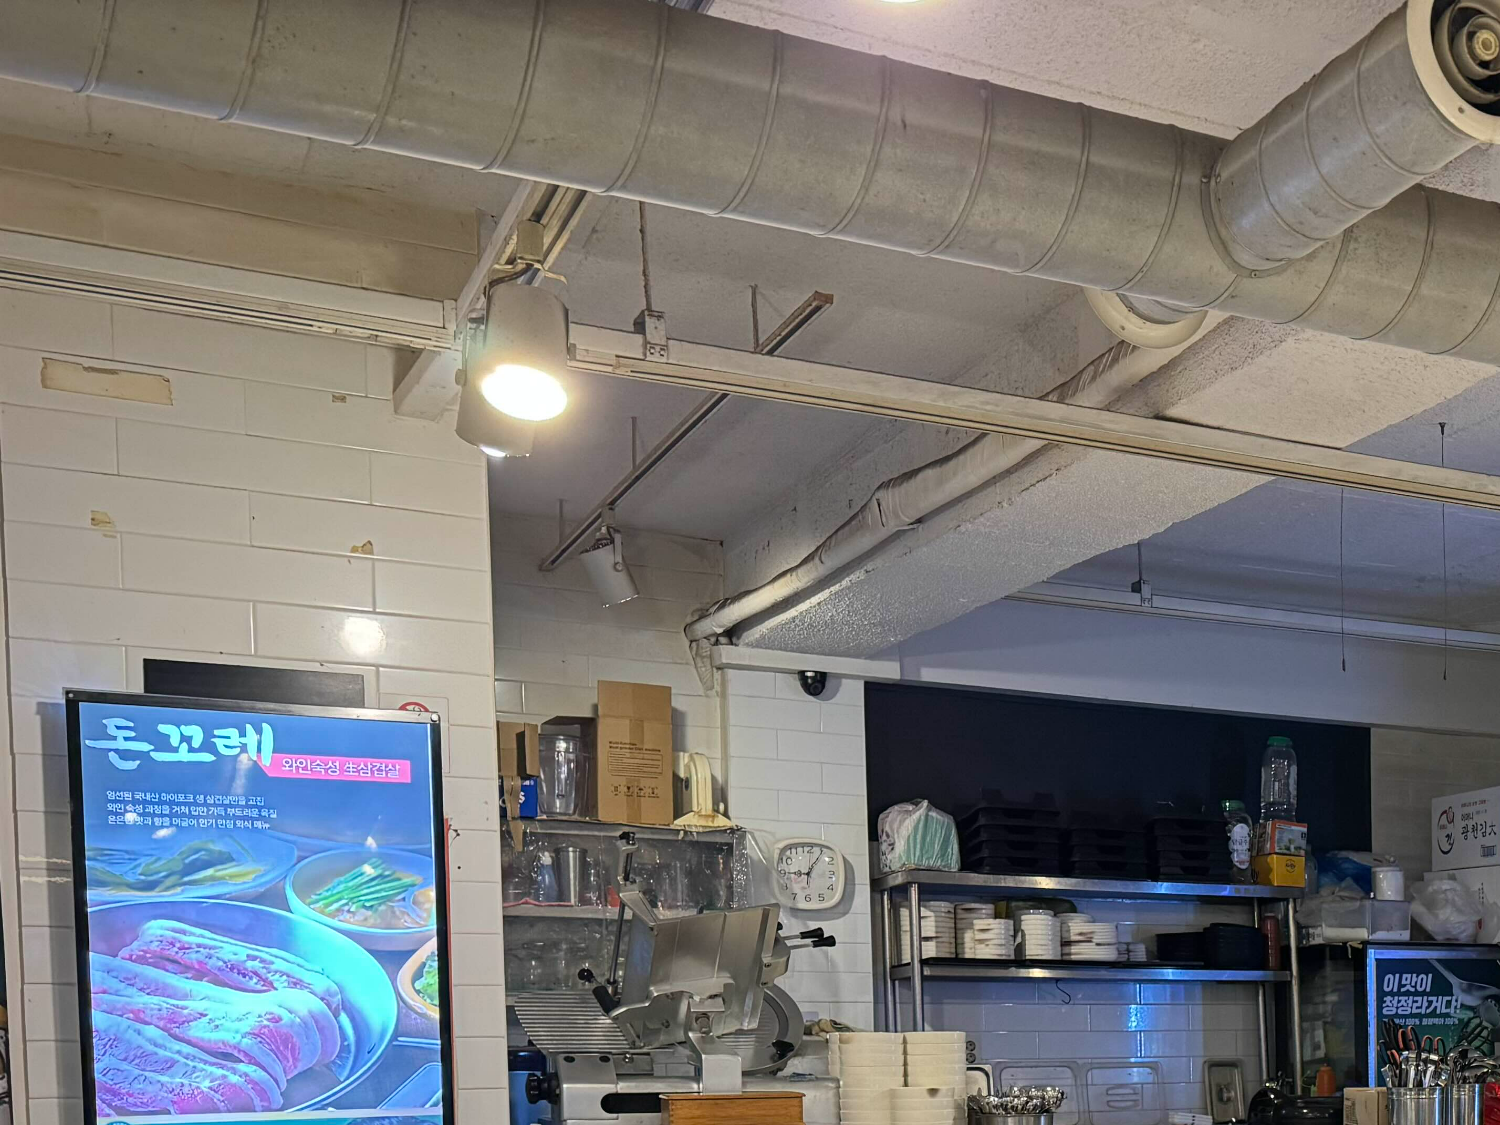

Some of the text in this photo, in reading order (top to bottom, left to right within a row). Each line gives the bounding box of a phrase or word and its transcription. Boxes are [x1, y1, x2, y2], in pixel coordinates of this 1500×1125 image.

[85, 717, 274, 771] 돈꼬레
[281, 758, 400, 779] 와인숙성 生삼겹살
[133, 791, 160, 802] 국내산
[106, 803, 125, 813] 와인
[144, 804, 170, 815] 과정을
[189, 806, 208, 817] 입안
[208, 807, 226, 817] 가득
[226, 808, 260, 818] 부드러운
[153, 816, 171, 827] 향을
[172, 817, 198, 828] 머금어
[199, 818, 216, 829] 인기
[235, 820, 252, 830] 외식
[789, 847, 798, 855] 11
[802, 846, 814, 854] 12
[780, 856, 793, 866] 10
[827, 856, 835, 866] 2
[779, 868, 787, 878] 9
[828, 870, 836, 880] 3
[826, 883, 834, 892] 4
[791, 892, 798, 901] 7
[804, 893, 812, 903] 6
[818, 893, 826, 902] 5
[1382, 995, 1461, 1015] 청정라거다!
